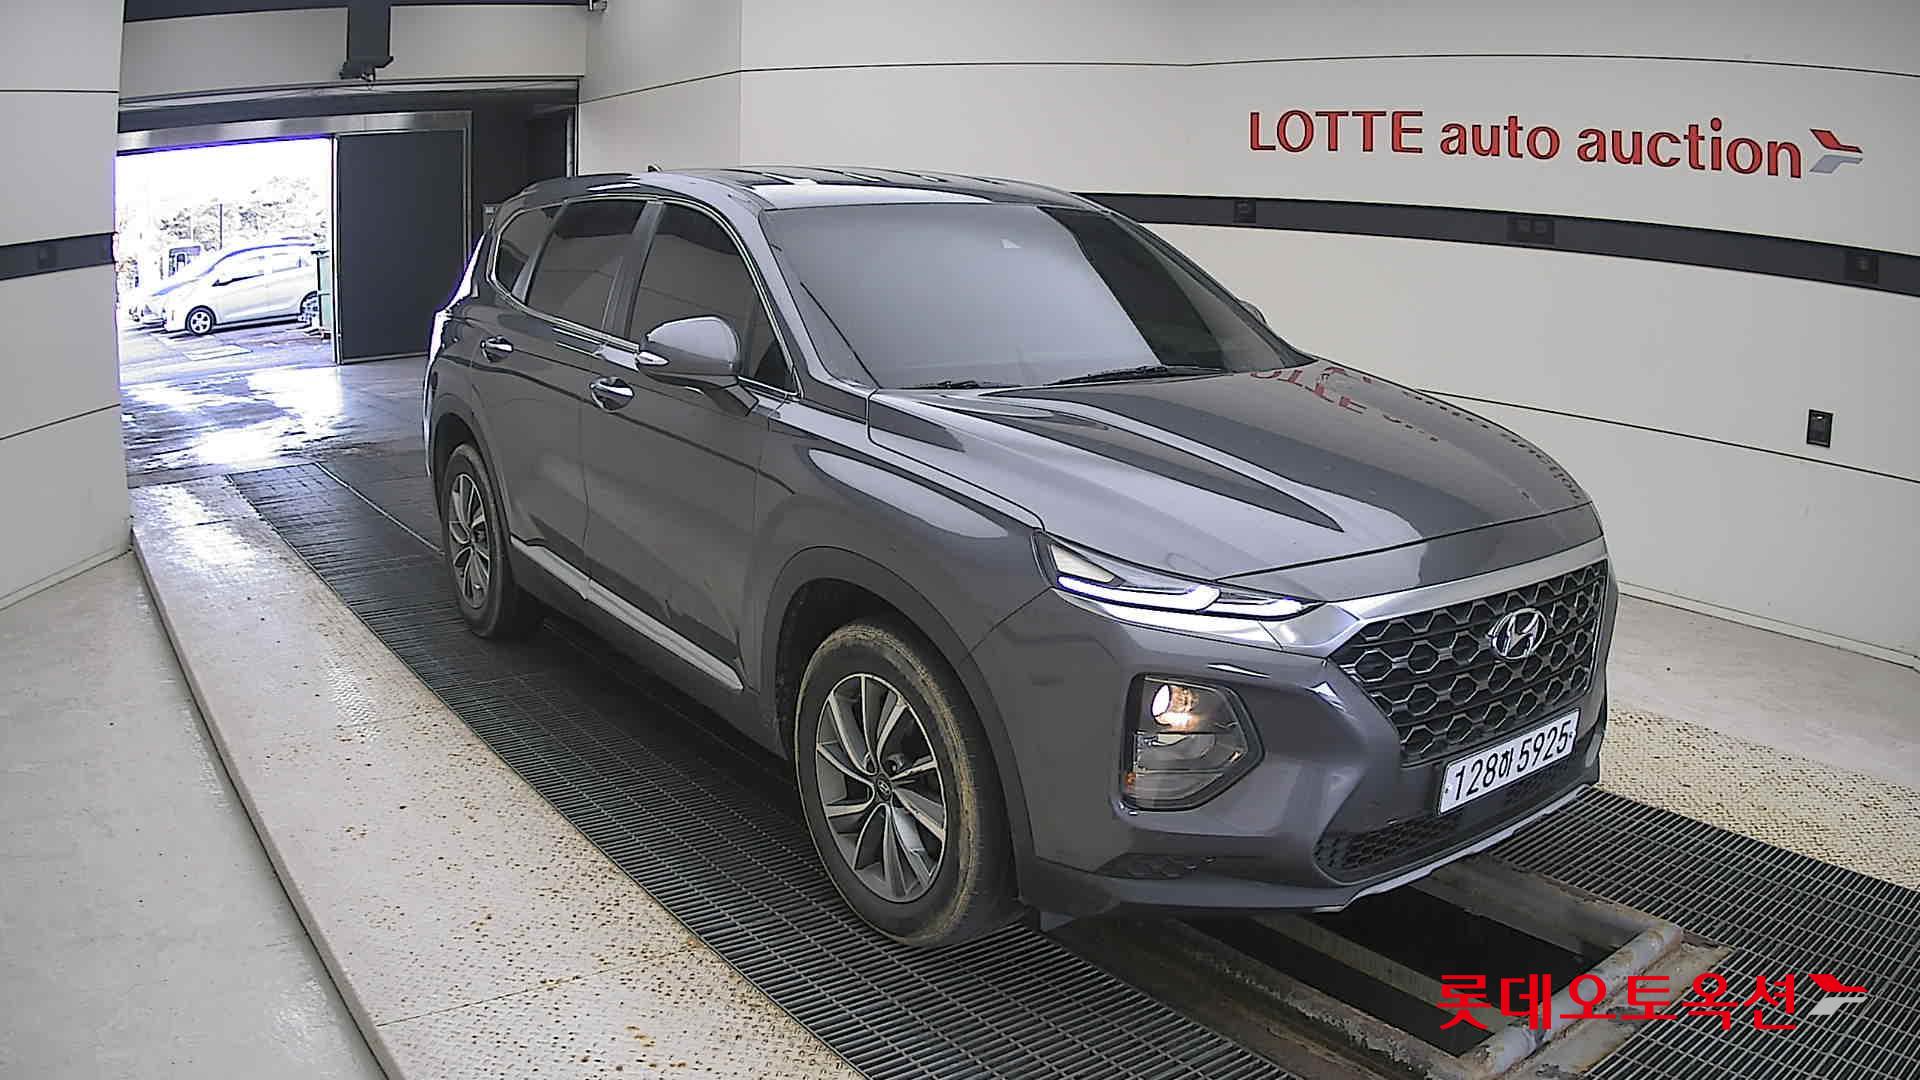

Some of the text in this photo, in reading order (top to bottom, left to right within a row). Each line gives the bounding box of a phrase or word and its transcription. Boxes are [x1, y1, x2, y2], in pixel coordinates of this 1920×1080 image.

[1249, 110, 1802, 179] LOTTE auto auction
[1516, 719, 1571, 773] 5925
